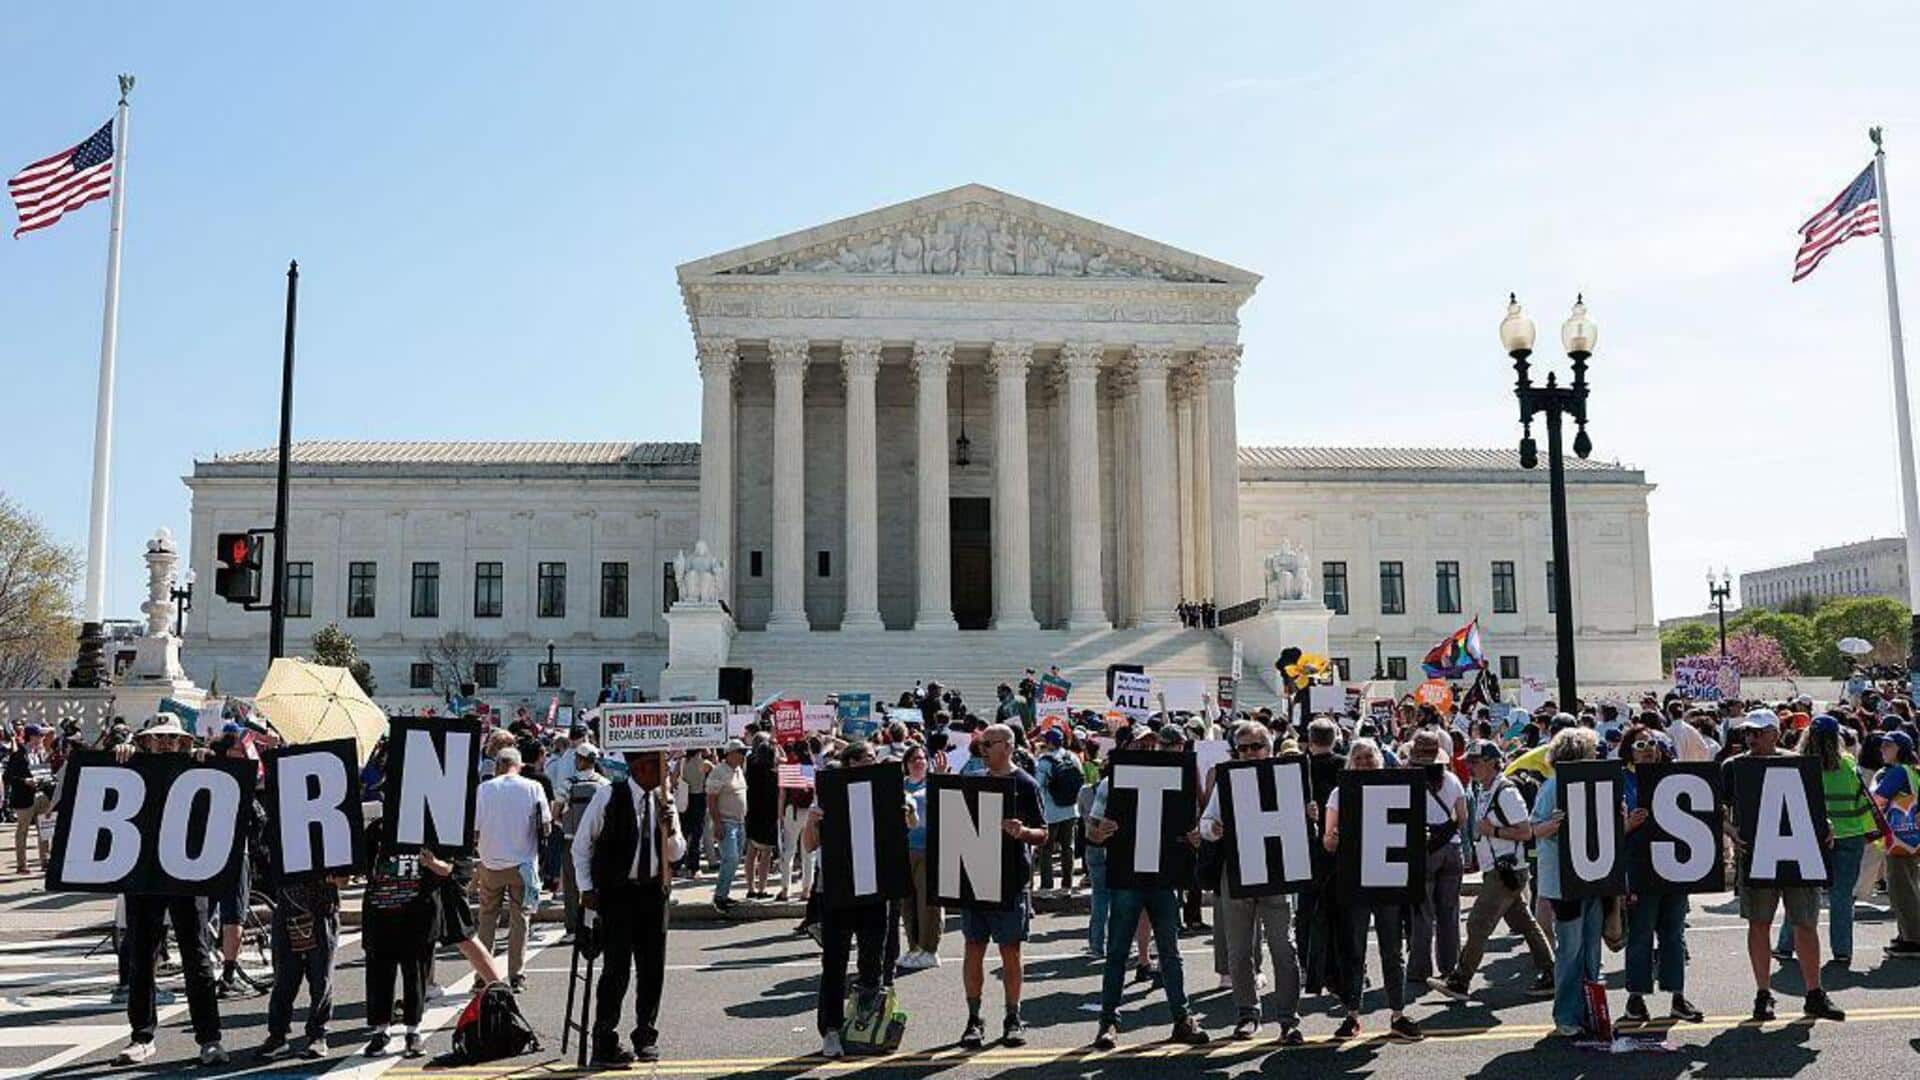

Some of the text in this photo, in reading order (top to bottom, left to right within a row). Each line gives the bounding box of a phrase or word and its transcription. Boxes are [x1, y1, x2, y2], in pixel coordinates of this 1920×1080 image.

[1115, 695, 1149, 710] ALL
[609, 712, 723, 728] STOP HATING EACH OTHER
[609, 729, 646, 741] BECAUSE
[648, 729, 665, 740] YOU
[62, 730, 1826, 901] BORN IN THE USA
